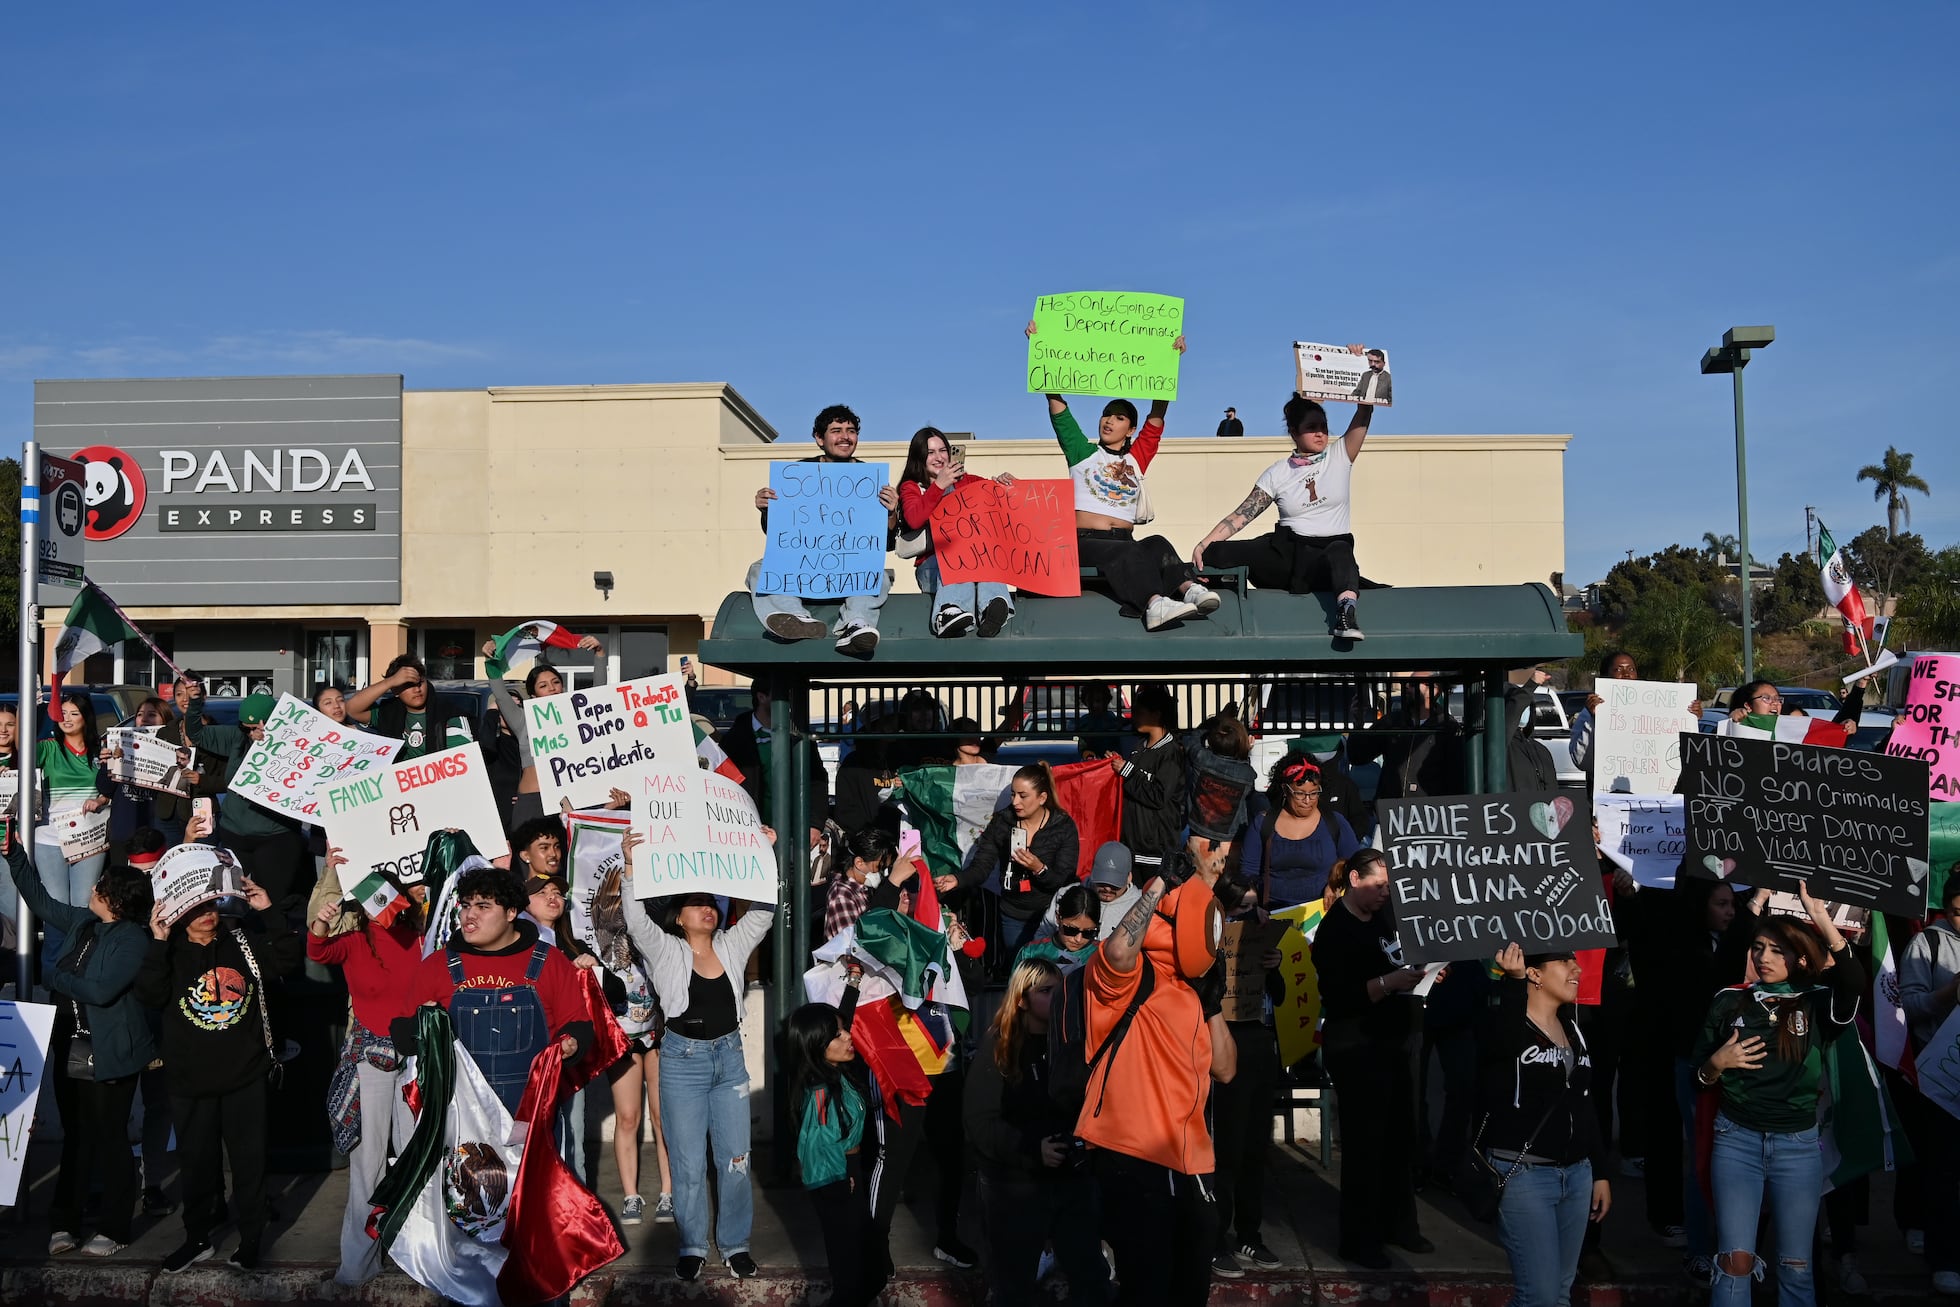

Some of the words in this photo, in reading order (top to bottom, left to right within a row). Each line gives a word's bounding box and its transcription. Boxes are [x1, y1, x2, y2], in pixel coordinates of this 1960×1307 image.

[1064, 313, 1120, 333] Deport
[1034, 340, 1072, 360] Since
[1074, 347, 1117, 363] when
[1121, 352, 1146, 366] are
[1029, 364, 1100, 391] Children
[159, 448, 376, 494] PANDA
[780, 464, 880, 498] School
[168, 508, 366, 526] EXPRESS
[819, 503, 855, 526] for
[931, 488, 978, 521] WE
[40, 540, 58, 560] 929
[778, 529, 880, 551] Education
[800, 552, 859, 572] NOT
[1913, 660, 1939, 679] WE
[1611, 684, 1638, 708] NO
[1642, 690, 1678, 708] ONE
[278, 701, 318, 732] Mi
[532, 702, 563, 730] Mi
[570, 693, 613, 722] Papa
[1904, 704, 1942, 723] FOR
[578, 717, 625, 745] Duro
[1633, 739, 1656, 756] ON
[1603, 755, 1659, 776] STOLEN
[1772, 744, 1882, 782] Padres
[328, 772, 384, 814] FAMILY
[394, 752, 468, 794] BELONGS
[644, 774, 686, 796] MAS
[1700, 770, 1745, 798] NO
[1760, 776, 1811, 803] Son
[1817, 783, 1925, 817] Criminales
[649, 800, 686, 820] QUE
[706, 801, 762, 827] NUNCA
[1388, 804, 1469, 837] NADIE
[1483, 802, 1517, 835] ES
[650, 824, 676, 844] LA
[707, 824, 761, 848] LUCHA
[1620, 821, 1654, 836] more
[1822, 814, 1913, 847] Darme
[1622, 840, 1650, 856] then
[651, 851, 765, 884] CONTINUA
[1395, 877, 1441, 904] EN
[1451, 872, 1528, 905] UNA
[1534, 874, 1555, 896] VIVA
[1401, 914, 1508, 947] Tierra
[1290, 950, 1312, 1030] RAZA
